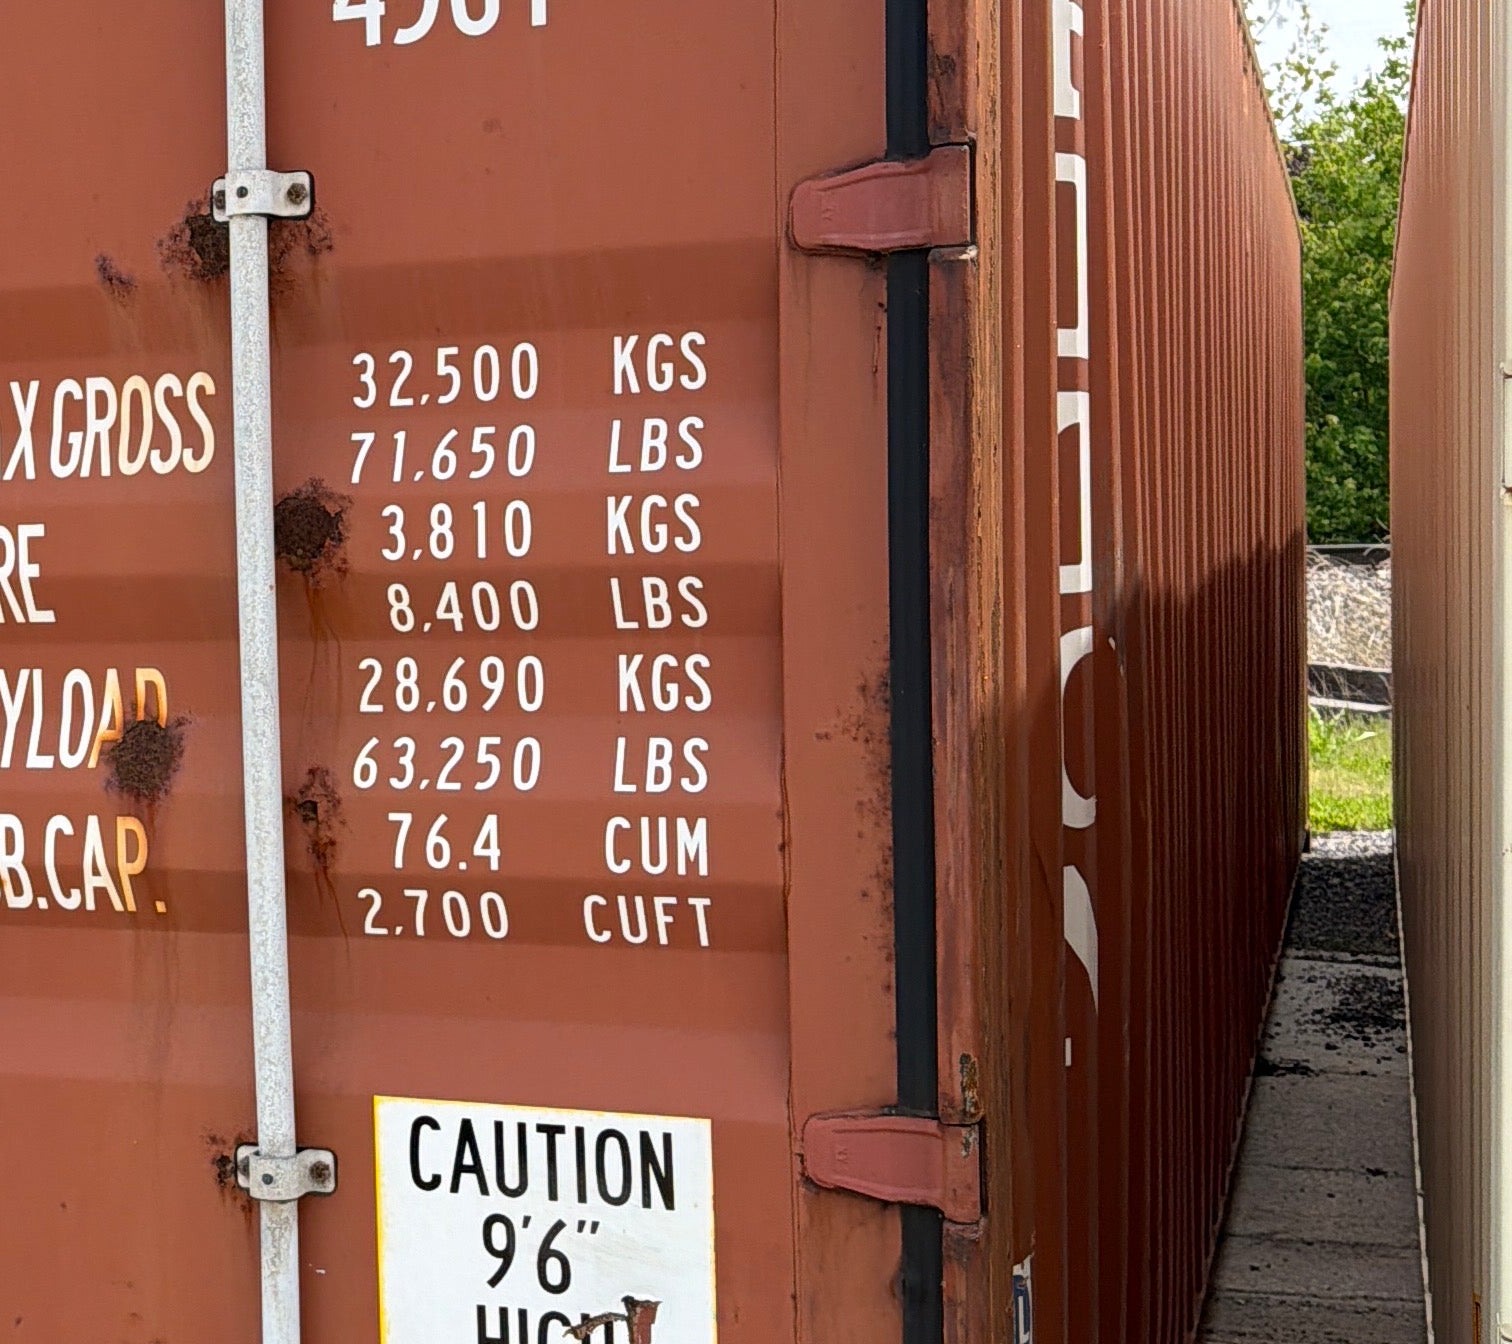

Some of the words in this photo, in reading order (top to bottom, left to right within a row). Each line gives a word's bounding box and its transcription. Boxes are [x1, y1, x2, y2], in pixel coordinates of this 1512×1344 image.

[352, 342, 539, 409] 32,500
[612, 331, 707, 394] KGS
[50, 372, 216, 478] GROSS
[349, 424, 536, 484] 71,650
[609, 416, 704, 473] LBS
[382, 499, 533, 562] 3,810
[606, 493, 702, 555] KGS
[387, 579, 539, 634] 8,400
[611, 576, 709, 629] LBS
[358, 656, 545, 714] 28,690
[618, 653, 712, 712] KGS
[352, 736, 542, 792] 63,250
[613, 737, 709, 793] LBS
[388, 812, 502, 872] 76.4
[605, 816, 709, 876] CUM
[358, 887, 510, 940] 2,700
[583, 894, 712, 947] CUFT
[409, 1115, 675, 1211] CAUTION
